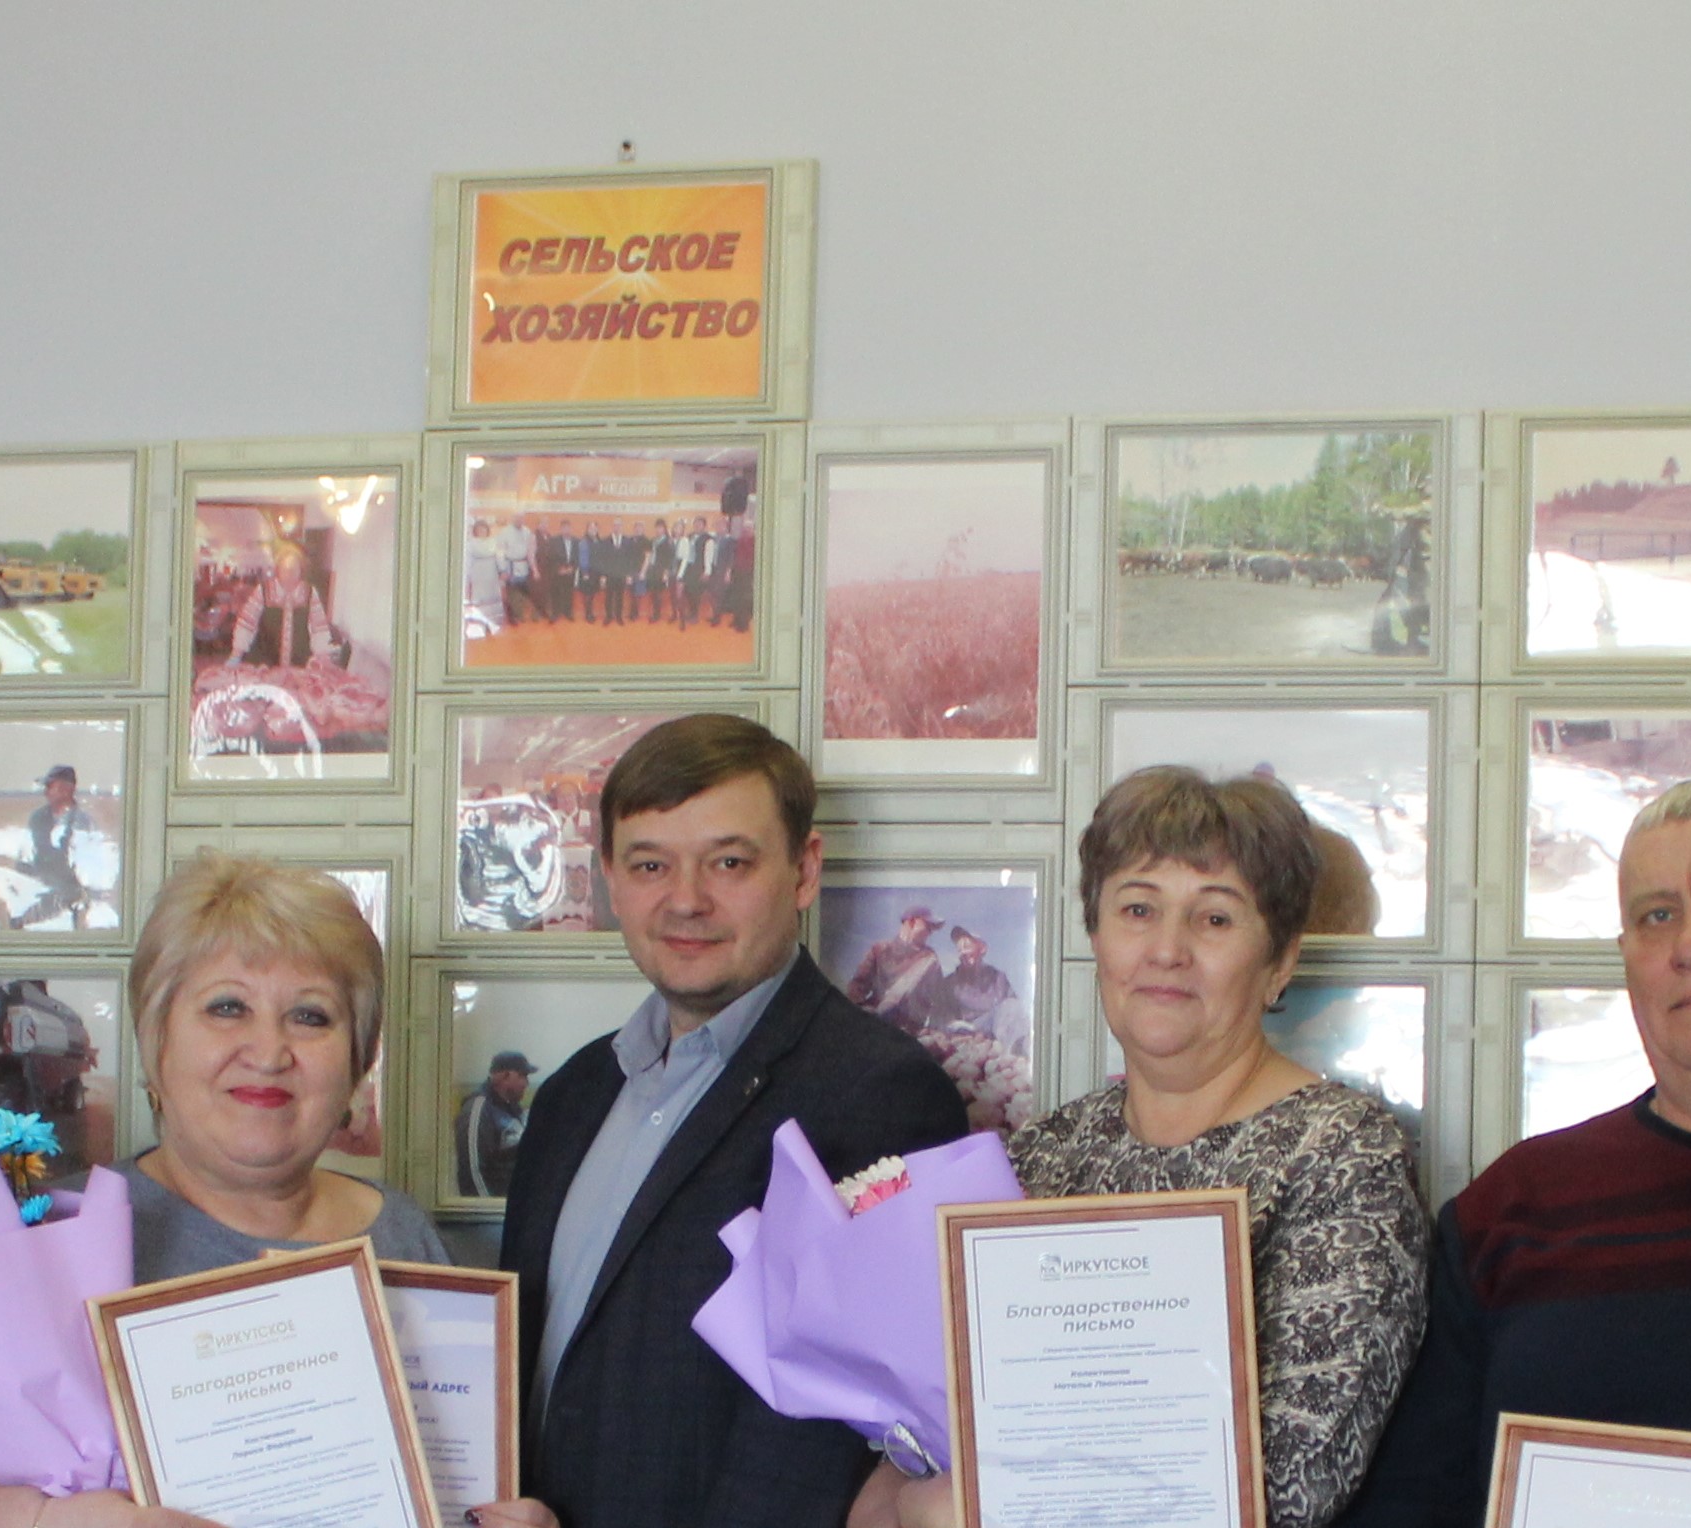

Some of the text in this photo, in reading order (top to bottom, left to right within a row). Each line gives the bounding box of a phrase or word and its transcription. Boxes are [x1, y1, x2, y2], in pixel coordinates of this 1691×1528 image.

[499, 231, 741, 276] СЕЛЬСКОЕ
[481, 293, 760, 345] ХОЗЯЙСТВО
[1062, 1256, 1150, 1274] ИРКУТСКОЕ
[1005, 1296, 1192, 1320] Благодарственное
[214, 1319, 296, 1348] ИРКУТСКОЕ
[1063, 1317, 1136, 1334] письмо
[170, 1350, 340, 1400] Благодарственное
[431, 1382, 471, 1395] АДРЕС
[226, 1378, 293, 1405] письмо
